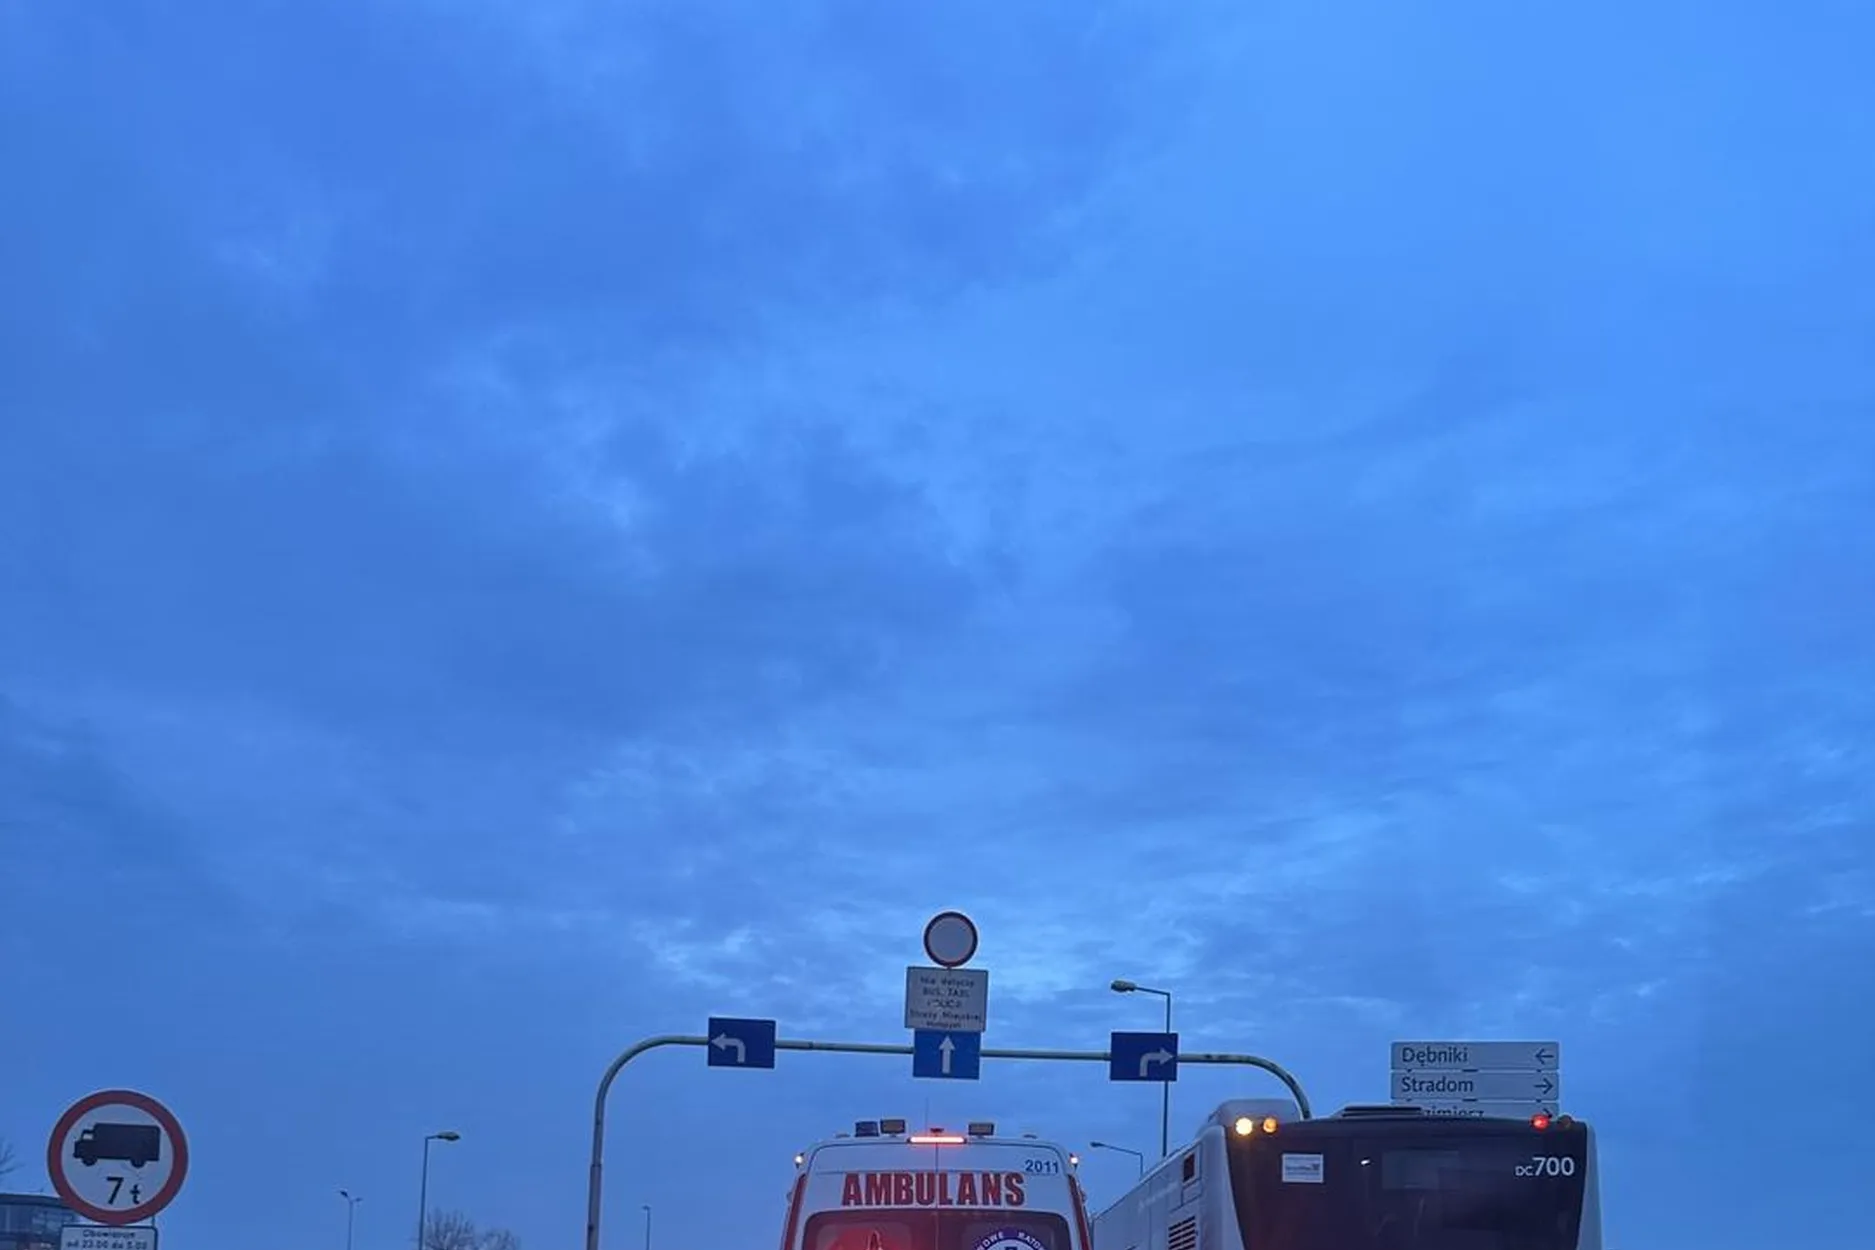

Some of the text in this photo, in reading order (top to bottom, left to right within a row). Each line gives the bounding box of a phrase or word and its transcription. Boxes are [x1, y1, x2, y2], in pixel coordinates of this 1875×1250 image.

[1402, 1047, 1468, 1066] Dębniki
[1402, 1076, 1474, 1093] Stradom
[1024, 1159, 1059, 1175] 2011
[106, 1176, 141, 1205] 7 t
[841, 1171, 1025, 1206] AMBULANS
